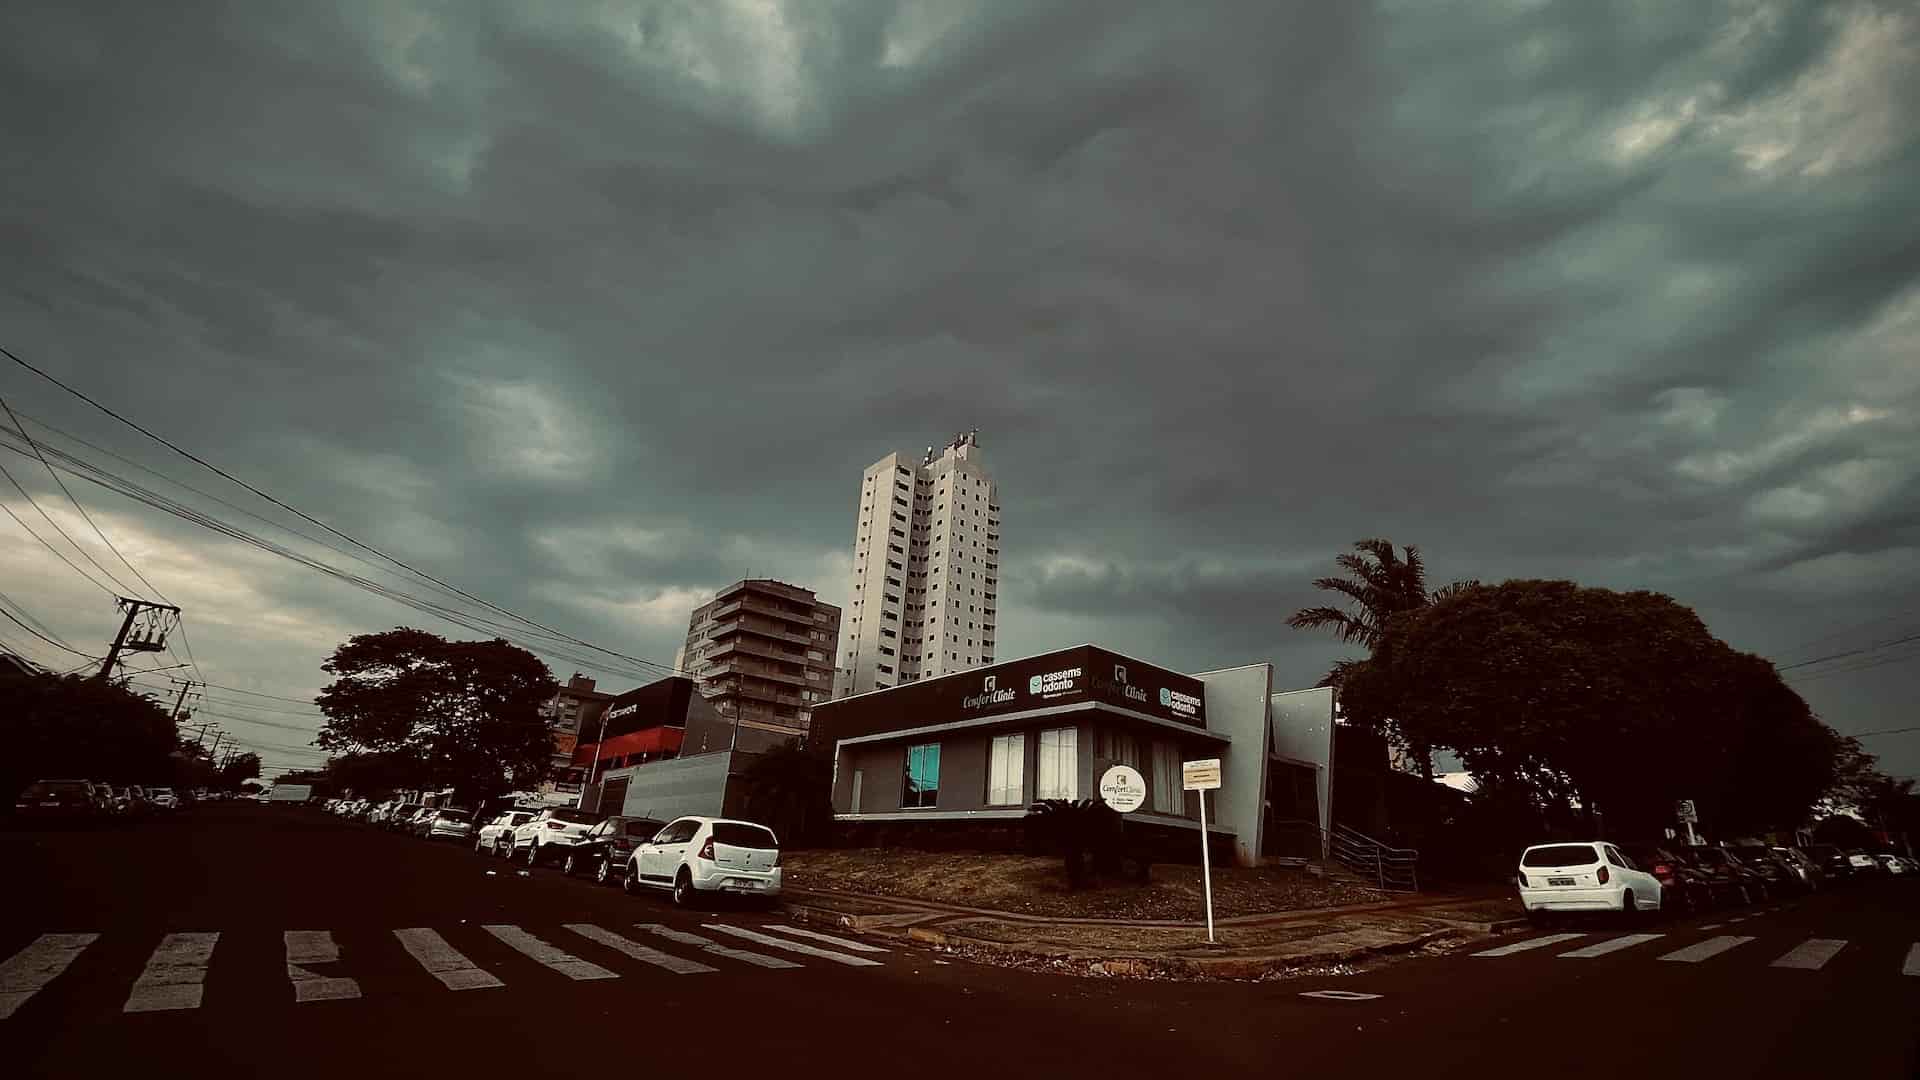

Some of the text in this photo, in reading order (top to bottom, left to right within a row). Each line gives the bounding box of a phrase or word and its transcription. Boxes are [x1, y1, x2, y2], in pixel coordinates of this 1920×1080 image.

[1043, 667, 1082, 682] cassems
[1042, 679, 1074, 693] odonto
[1170, 690, 1201, 707] cassems
[1170, 700, 1196, 715] odonto
